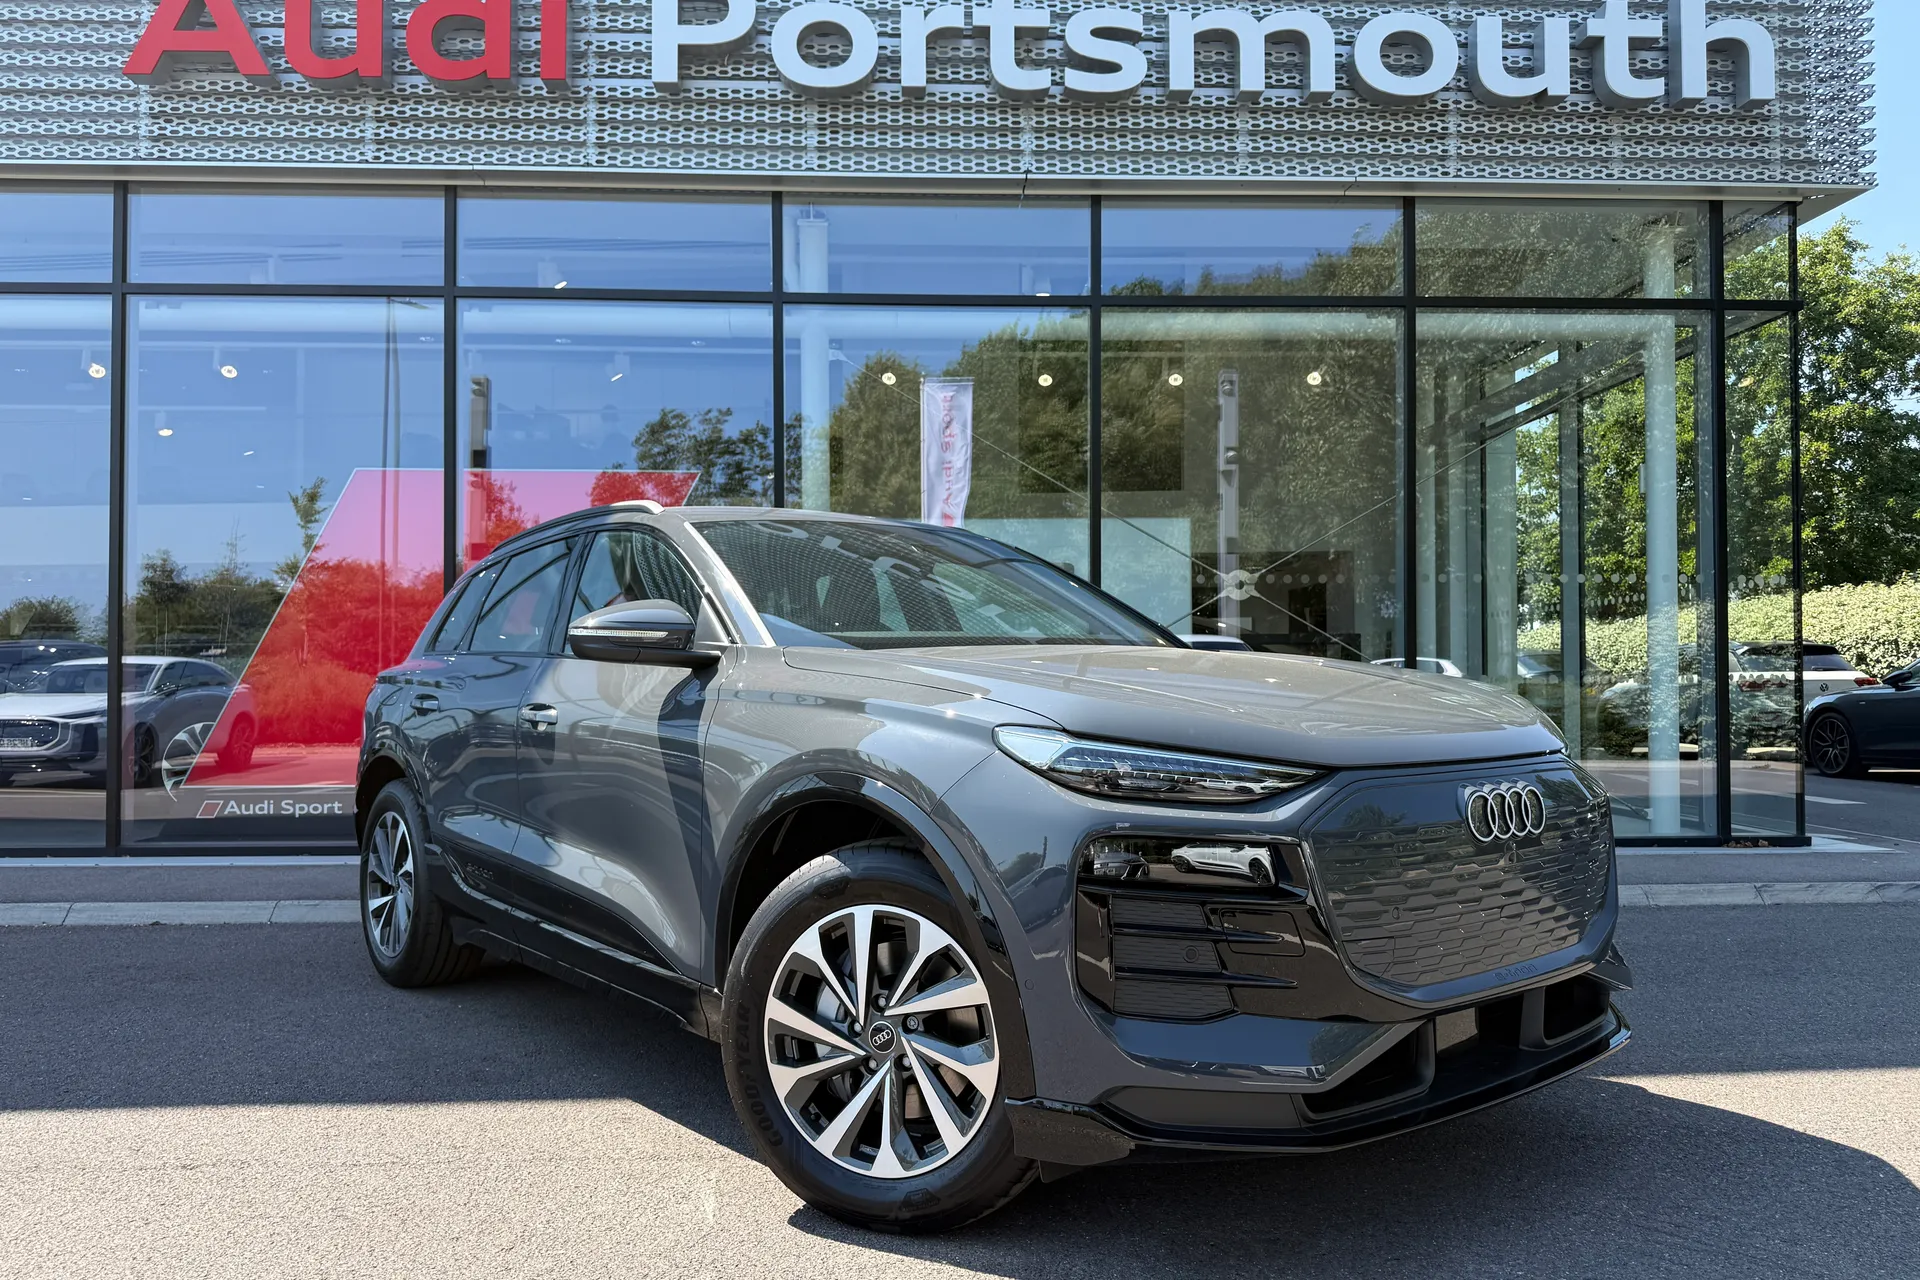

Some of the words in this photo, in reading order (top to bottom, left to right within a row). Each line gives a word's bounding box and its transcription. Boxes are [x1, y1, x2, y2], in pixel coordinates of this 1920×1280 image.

[121, 0, 569, 82] Audi
[651, 0, 1777, 103] Portsmouth
[224, 800, 274, 815] Audi
[280, 800, 343, 818] Sport
